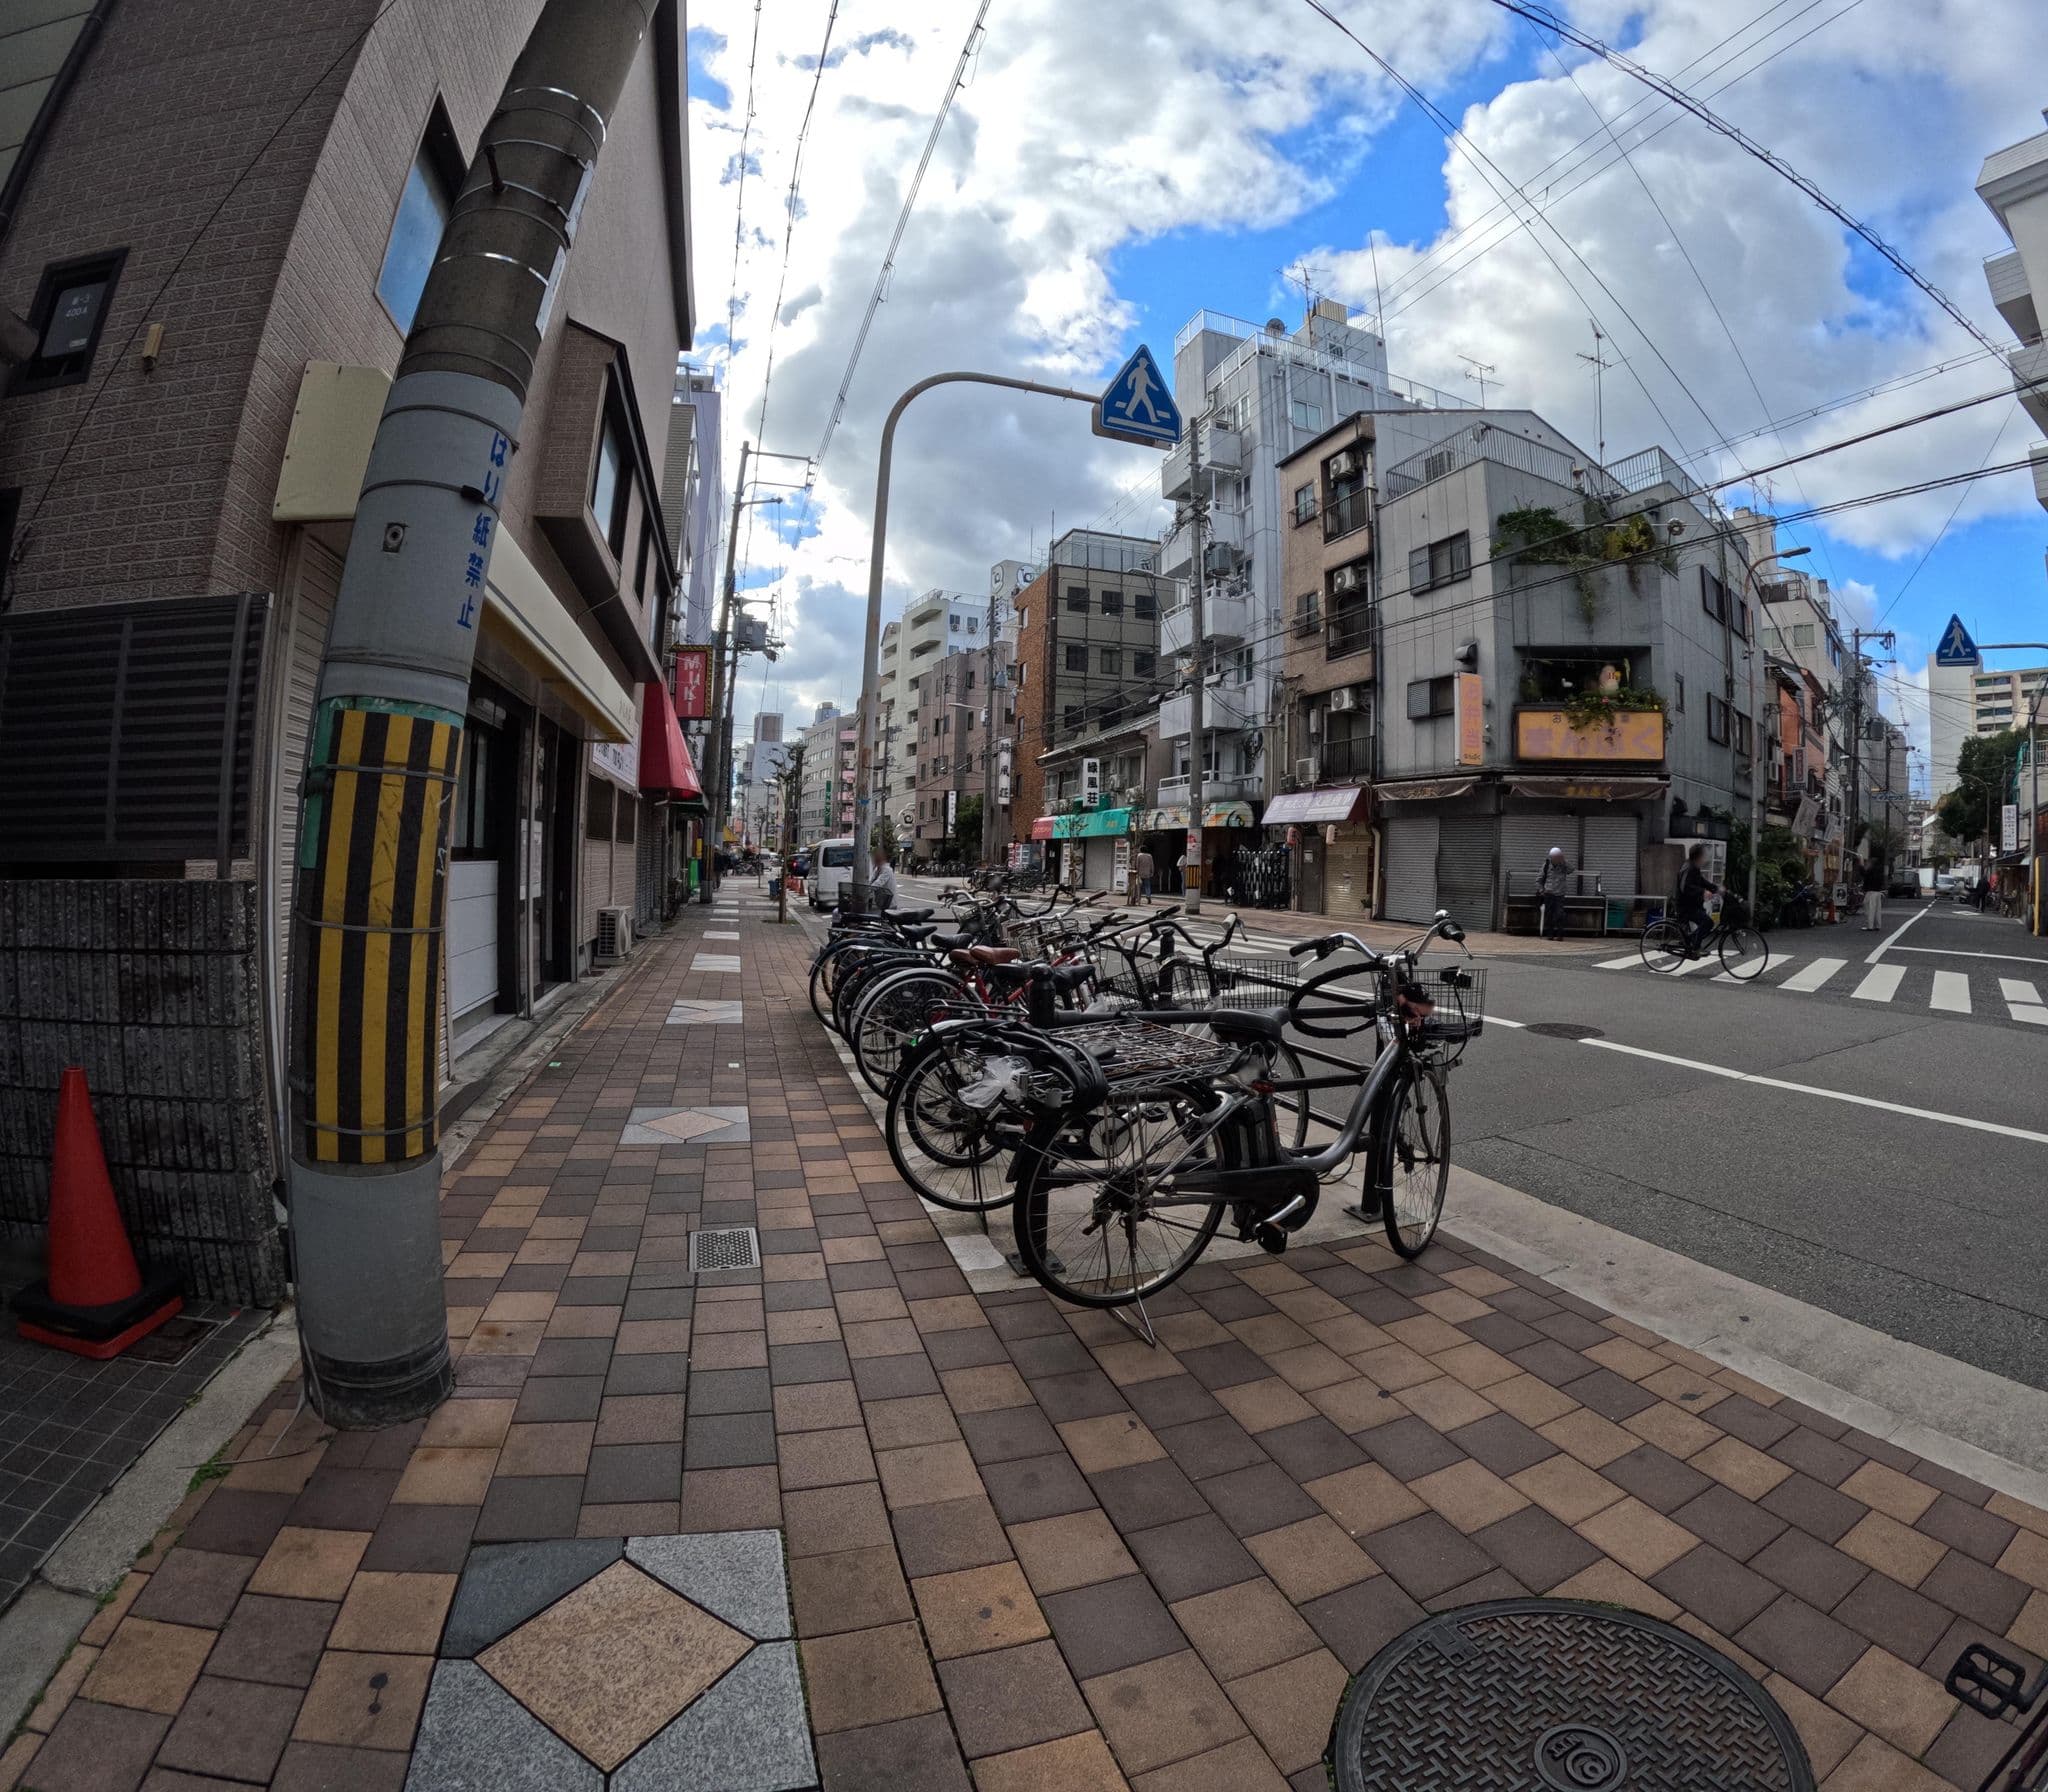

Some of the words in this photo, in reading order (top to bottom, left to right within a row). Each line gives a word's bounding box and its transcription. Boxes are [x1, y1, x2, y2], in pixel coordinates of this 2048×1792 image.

[457, 431, 508, 630] はり紙禁止
